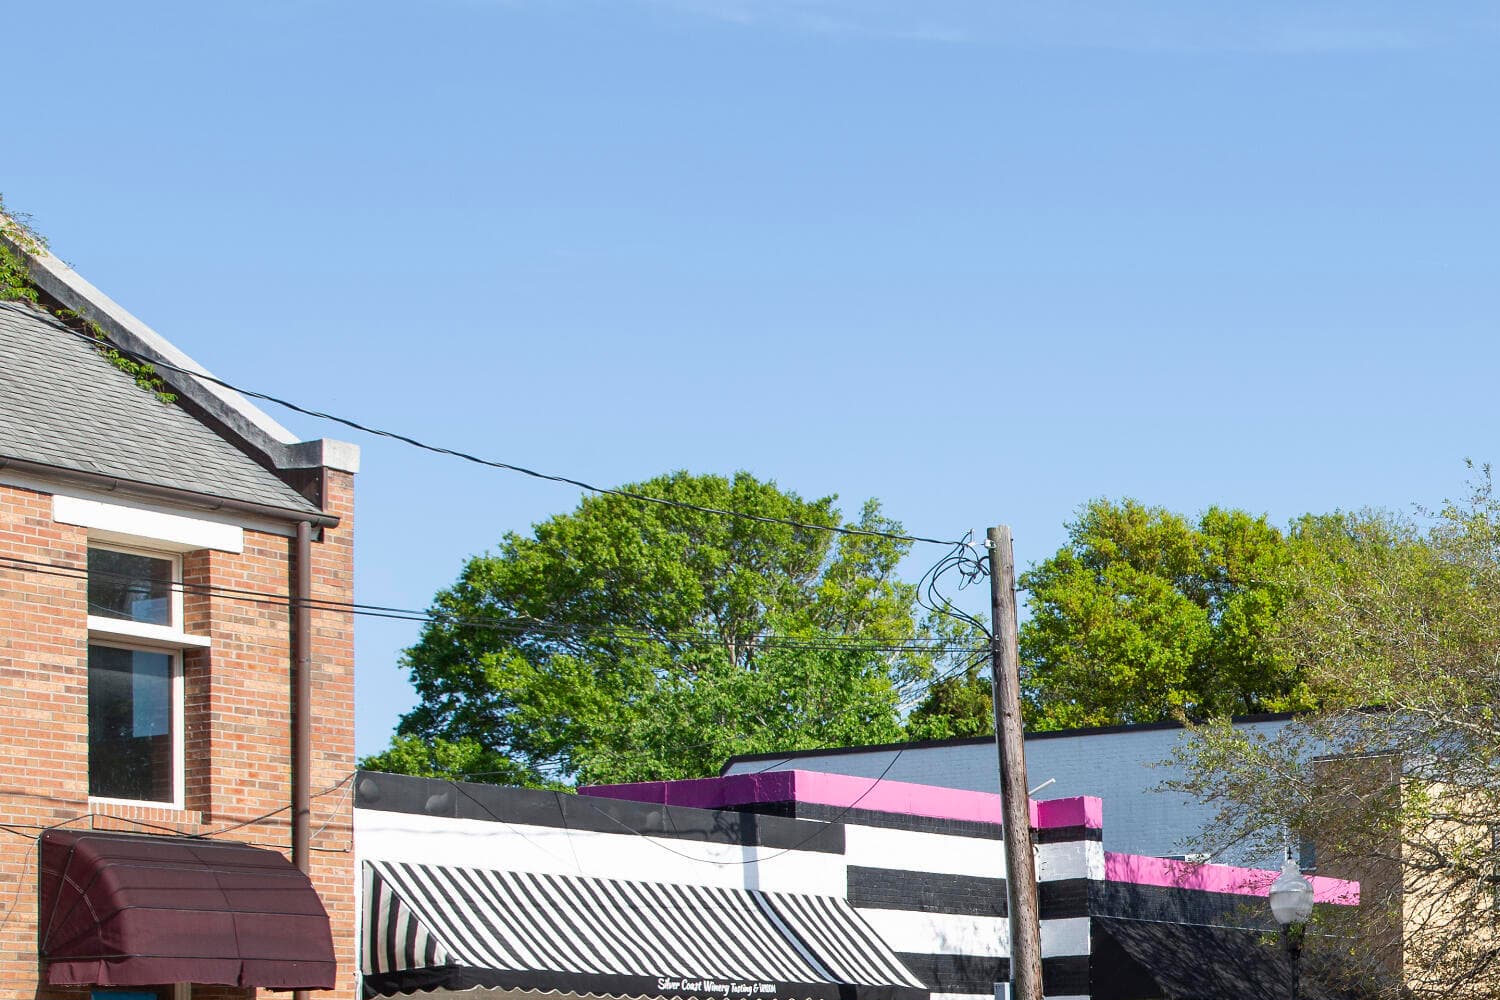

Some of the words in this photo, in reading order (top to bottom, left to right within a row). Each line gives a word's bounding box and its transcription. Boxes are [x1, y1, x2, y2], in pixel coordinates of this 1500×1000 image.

[658, 977, 680, 990] Silver
[681, 978, 702, 991] Coast
[703, 980, 730, 996] Winery
[730, 983, 752, 996] Tasting
[752, 983, 759, 993] &
